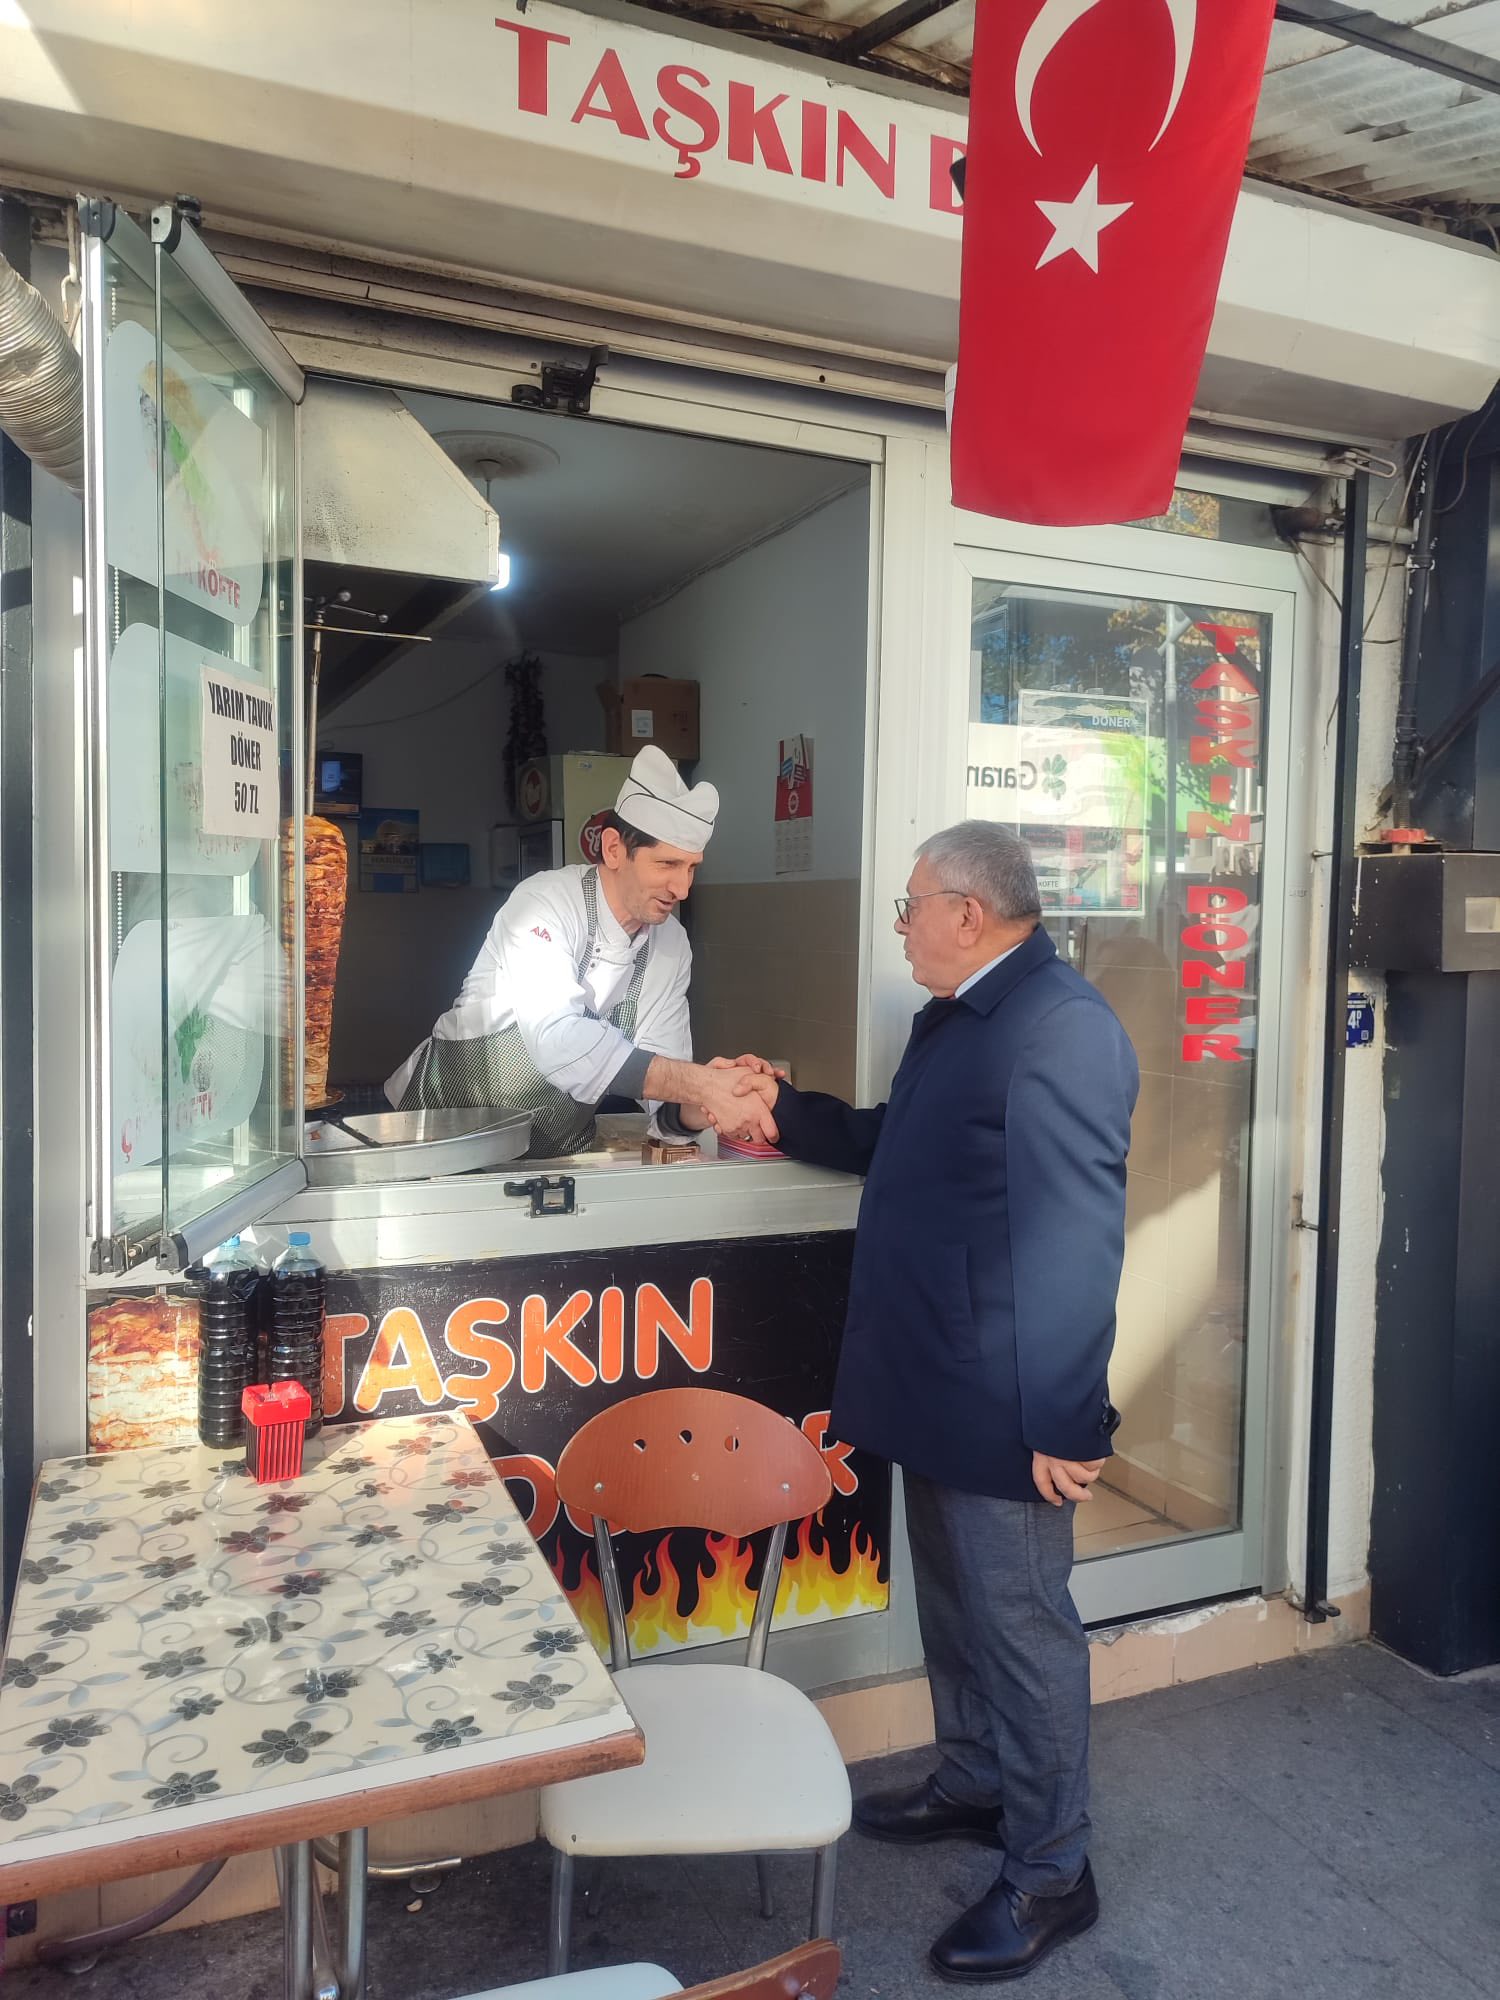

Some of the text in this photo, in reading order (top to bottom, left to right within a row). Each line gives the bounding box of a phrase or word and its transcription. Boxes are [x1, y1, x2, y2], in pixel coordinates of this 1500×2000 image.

[495, 18, 896, 200] TAŞKIN
[208, 681, 274, 732] YARIM TAVUK
[230, 730, 262, 771] DÖNER
[234, 781, 259, 815] 50 TL
[1181, 886, 1249, 1062] DÖNER
[323, 1277, 714, 1424] TAŞKIN
